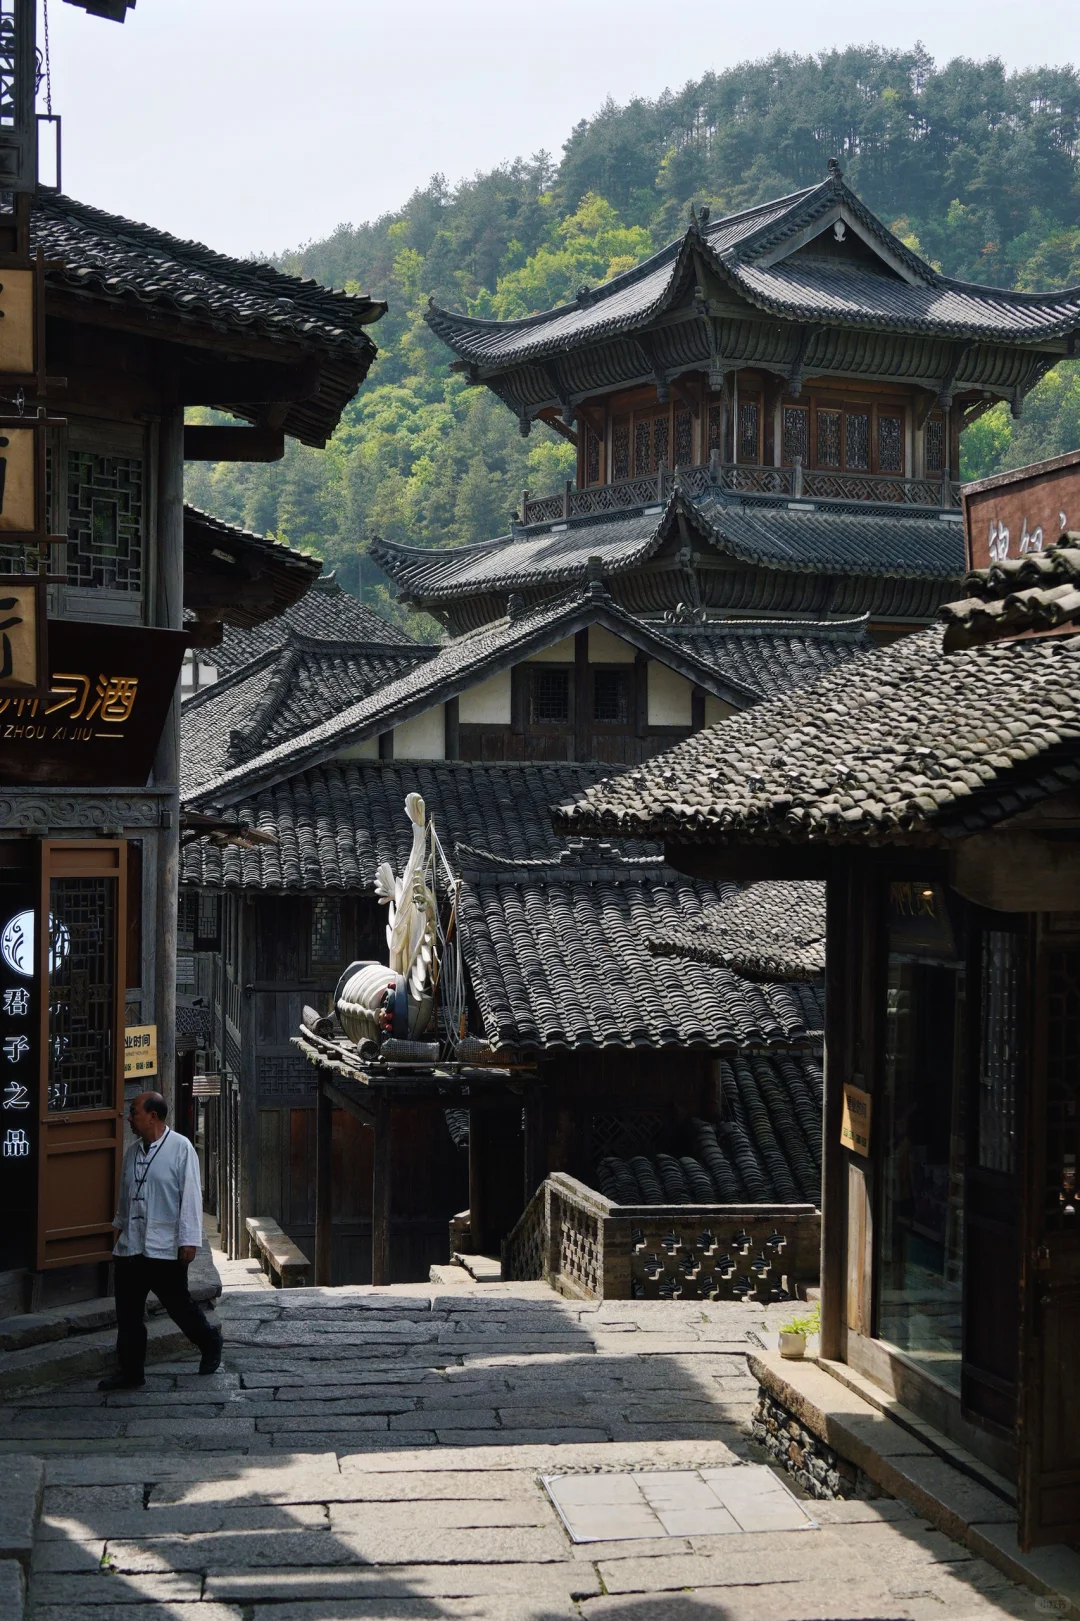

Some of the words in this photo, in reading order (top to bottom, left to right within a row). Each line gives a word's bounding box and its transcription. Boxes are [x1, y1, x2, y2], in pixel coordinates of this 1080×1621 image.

[0, 724, 47, 740] ZHOU
[3, 987, 30, 1157] 君子之品
